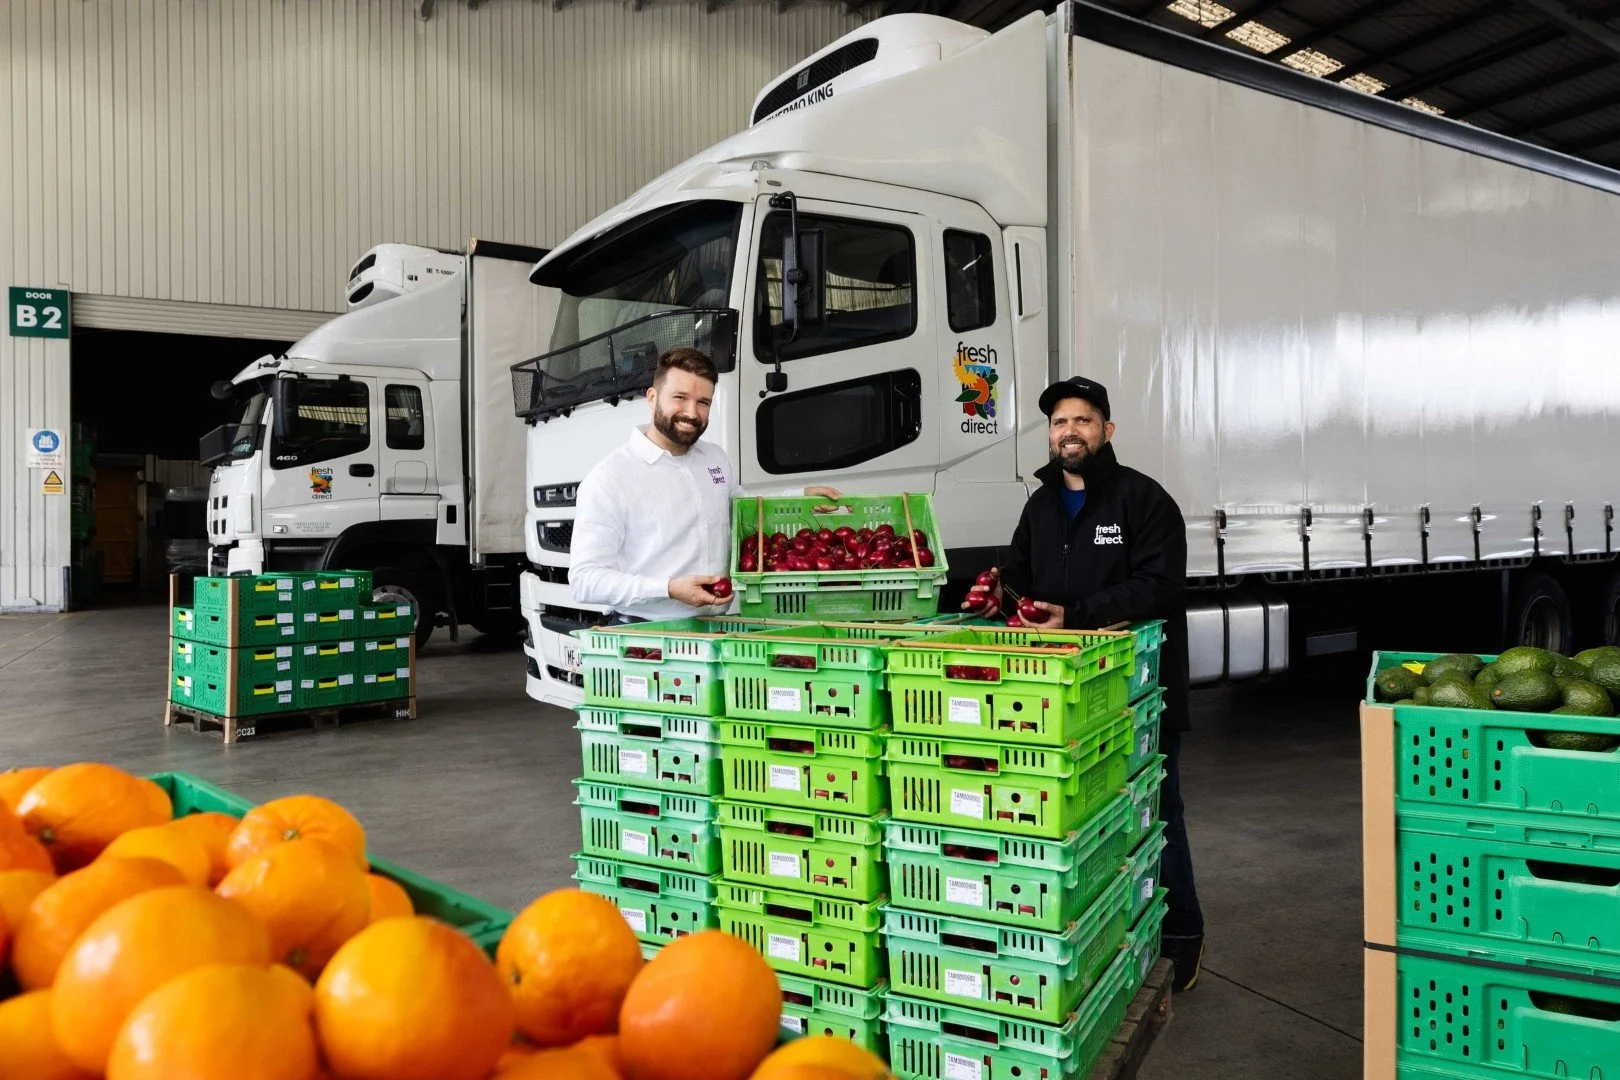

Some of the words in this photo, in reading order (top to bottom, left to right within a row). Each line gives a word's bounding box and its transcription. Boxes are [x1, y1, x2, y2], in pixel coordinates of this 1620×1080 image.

[807, 82, 834, 106] KING
[25, 291, 52, 300] DOOR
[956, 341, 998, 366] fresh
[960, 418, 998, 434] direct
[311, 466, 333, 476] fresh
[707, 465, 723, 478] fresh
[712, 475, 726, 484] direct
[545, 486, 577, 502] FU
[1095, 523, 1121, 538] fresh
[1093, 534, 1123, 545] direct
